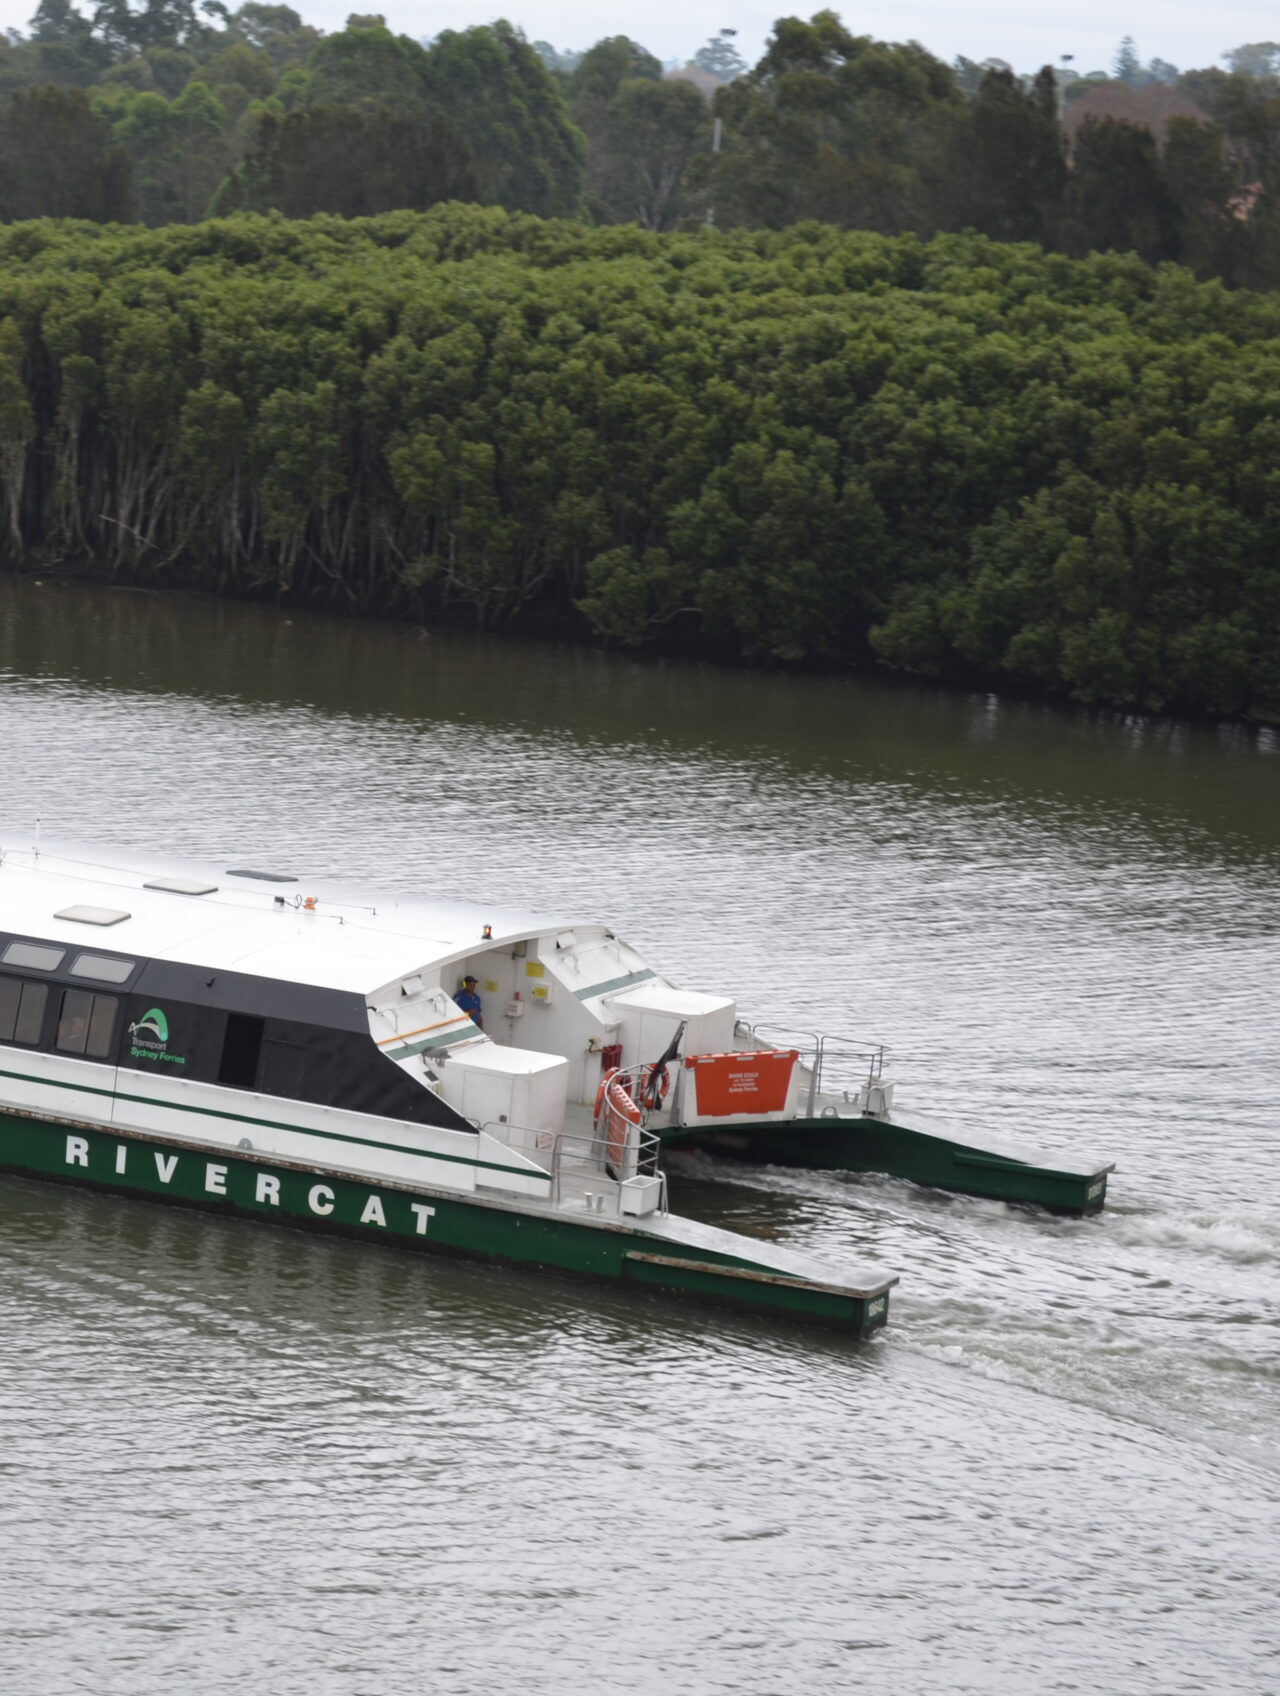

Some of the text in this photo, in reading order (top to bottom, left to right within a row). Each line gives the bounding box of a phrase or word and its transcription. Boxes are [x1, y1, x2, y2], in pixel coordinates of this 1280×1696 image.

[132, 1038, 167, 1050] Transport
[131, 1047, 185, 1064] Sydney Ferries
[65, 1135, 436, 1236] RIVERCAT
